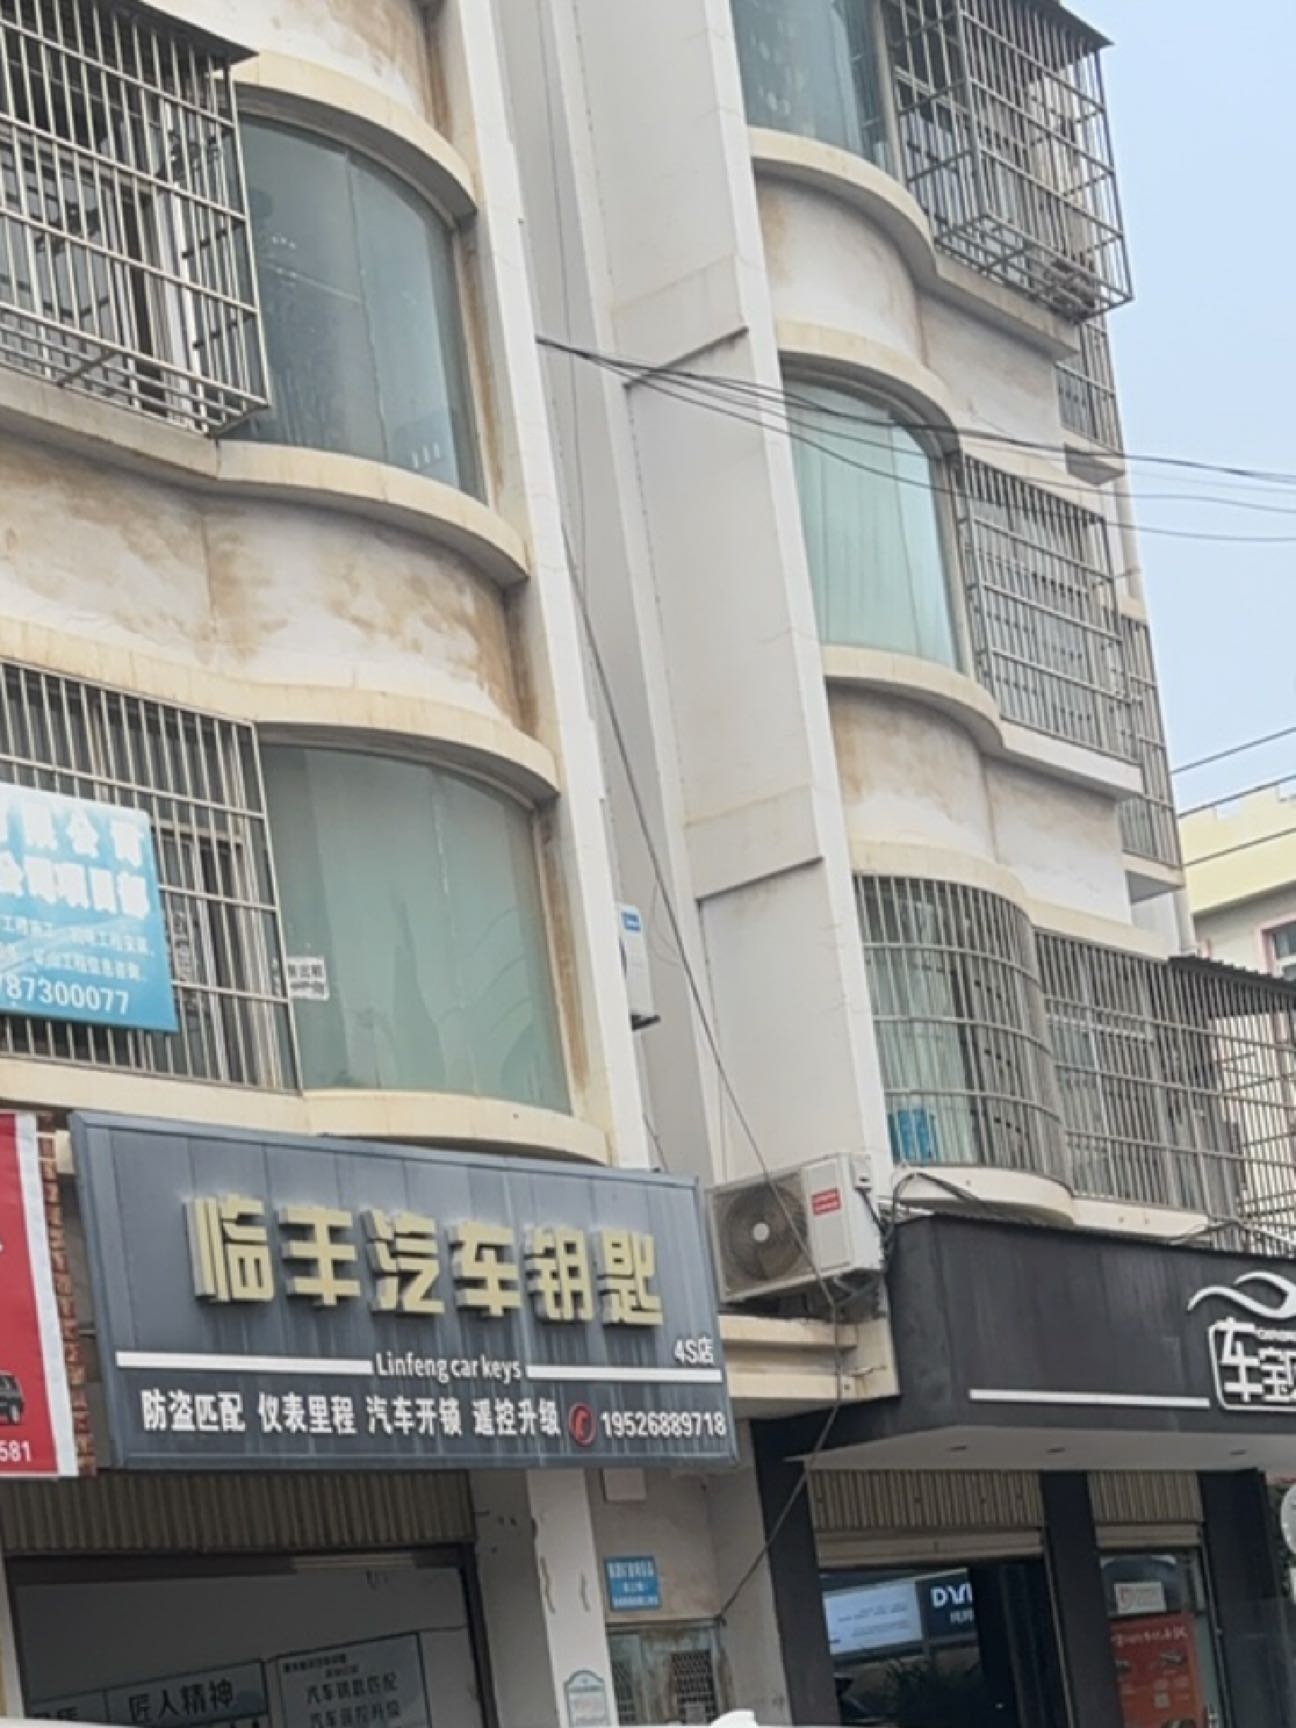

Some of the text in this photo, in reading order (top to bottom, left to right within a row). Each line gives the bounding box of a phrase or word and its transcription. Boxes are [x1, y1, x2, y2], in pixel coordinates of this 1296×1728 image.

[185, 1194, 663, 1327] 临丰汽车钥匙
[376, 1351, 448, 1383] Linfeng
[674, 1339, 714, 1366] 4S店
[1215, 1316, 1296, 1403] 车宝
[142, 1389, 727, 1440] 防盗匹配 仪表里程 汽车开锁 遥控升级 19526889718
[129, 1677, 233, 1722] 匠人精神
